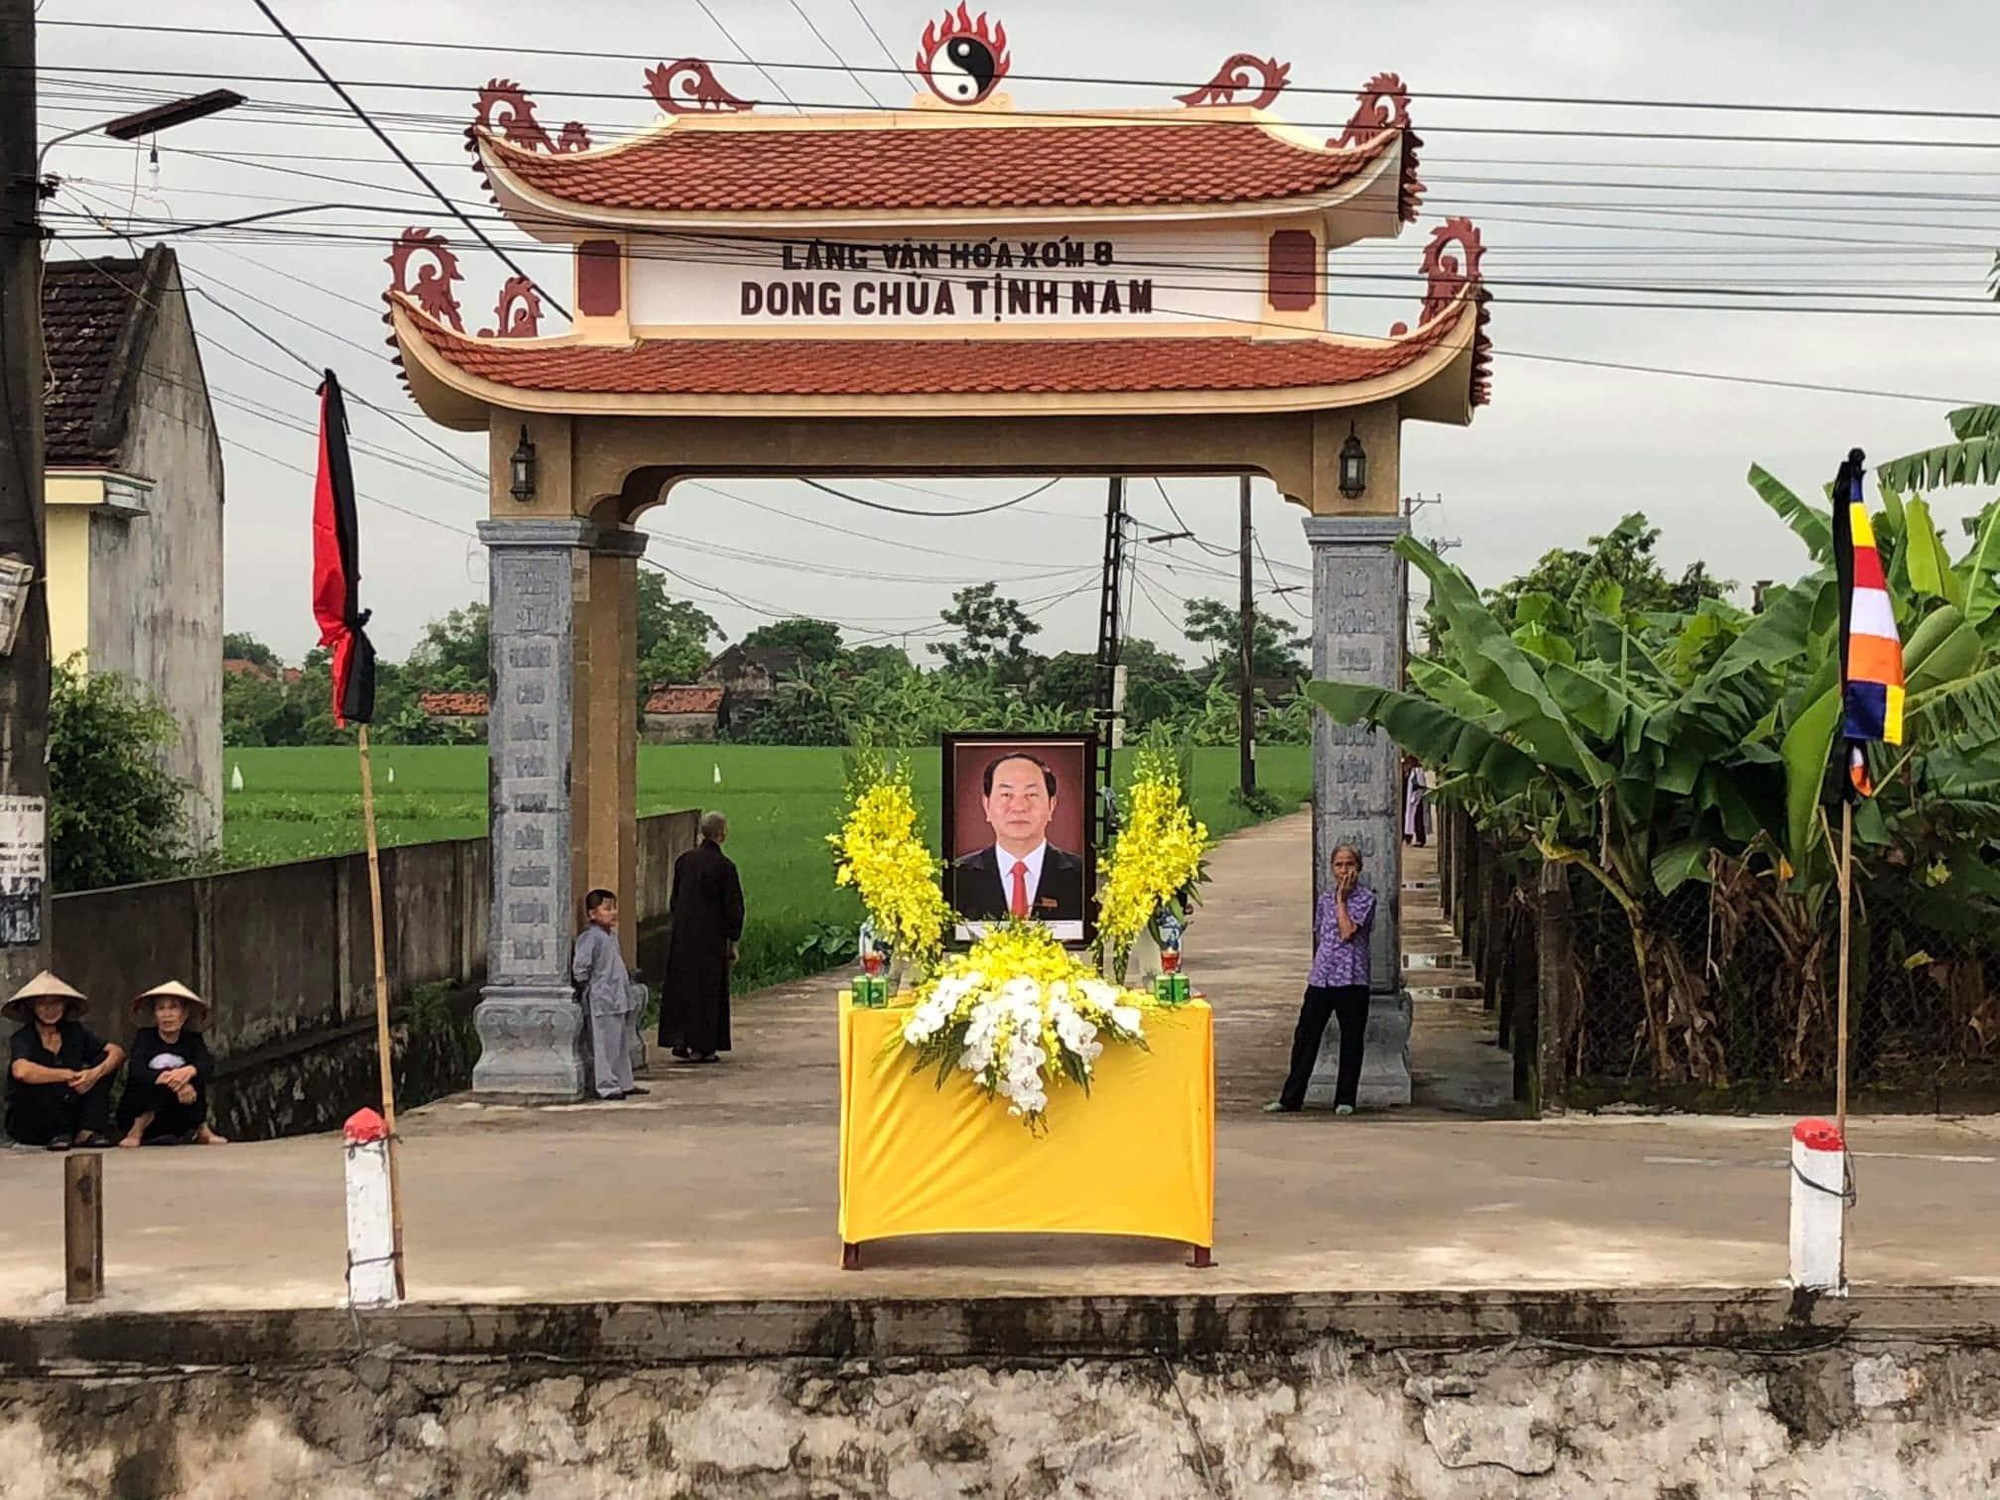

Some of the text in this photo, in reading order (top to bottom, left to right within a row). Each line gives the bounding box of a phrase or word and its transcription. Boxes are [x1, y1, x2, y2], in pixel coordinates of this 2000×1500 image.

[950, 236, 1013, 269] HÓA
[1020, 235, 1085, 268] XÓM
[1093, 241, 1114, 267] 8
[742, 281, 841, 316] DONG
[1072, 279, 1152, 315] NAM
